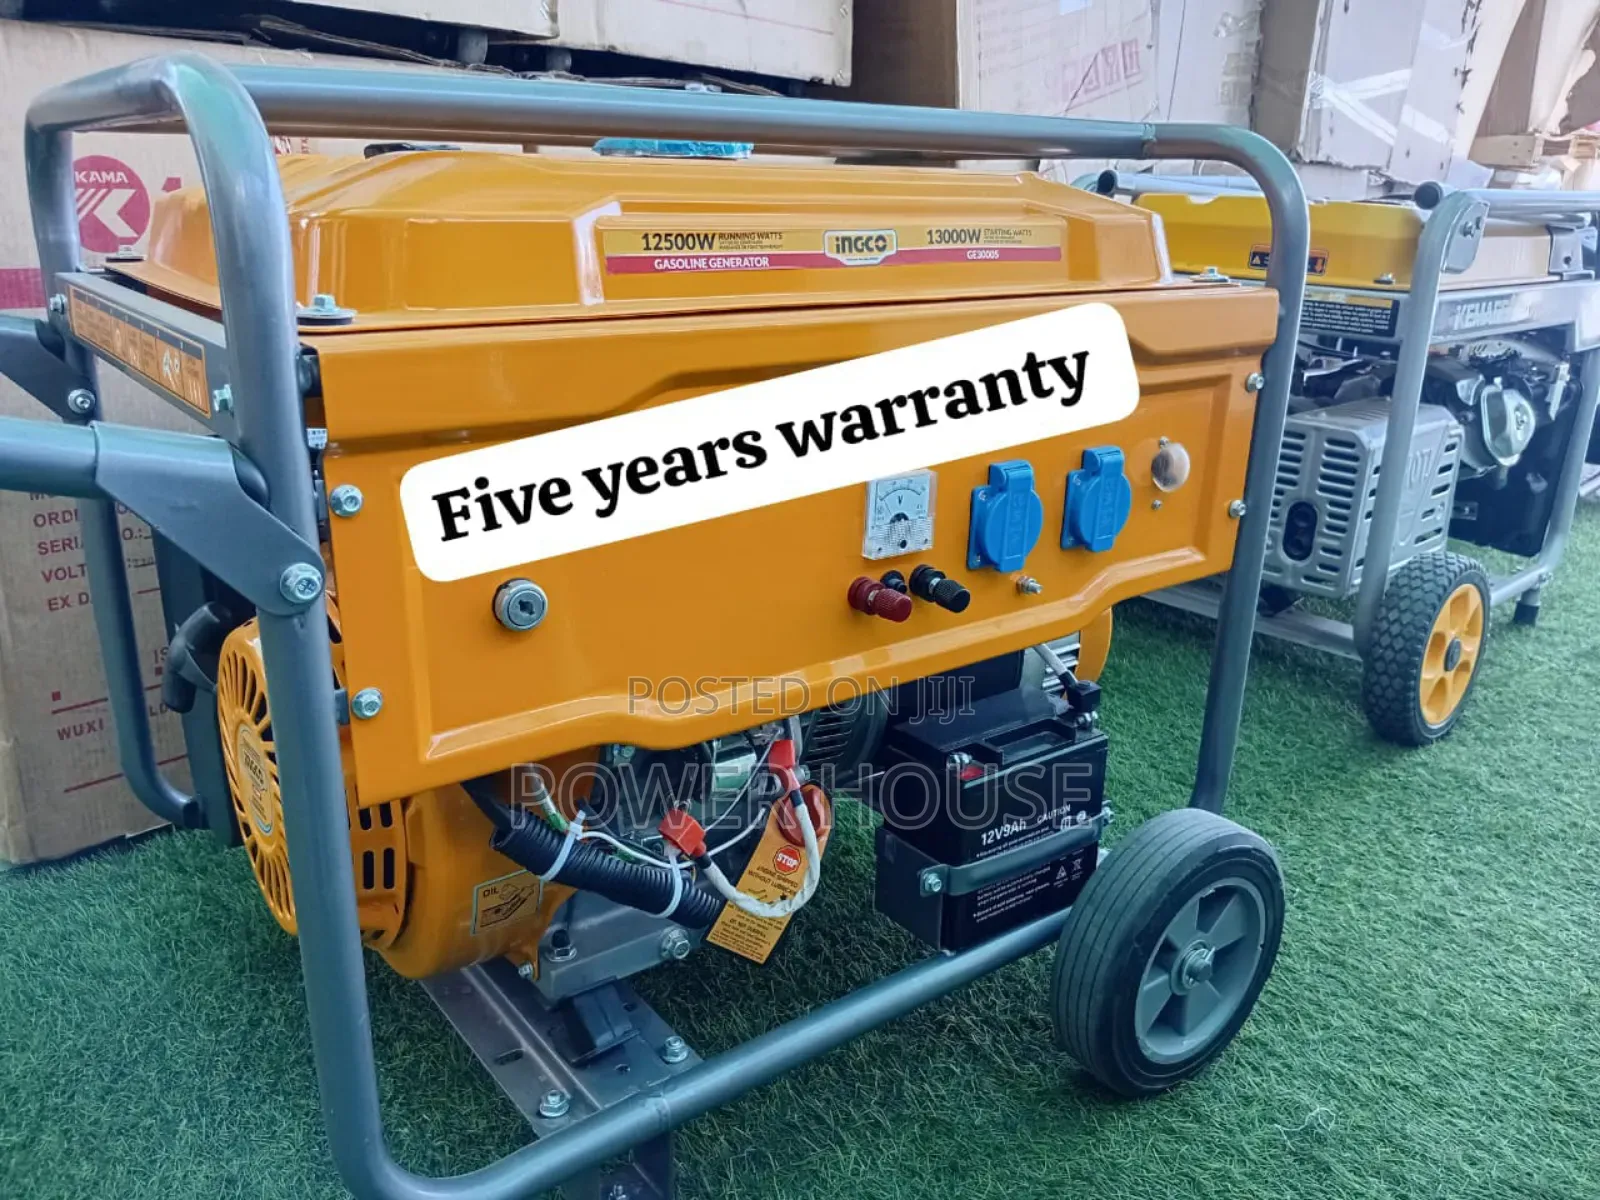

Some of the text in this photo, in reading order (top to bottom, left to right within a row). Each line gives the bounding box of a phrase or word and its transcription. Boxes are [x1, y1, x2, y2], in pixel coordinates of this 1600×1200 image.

[74, 170, 129, 184] KAMA
[641, 232, 715, 251] 12500W
[718, 231, 756, 242] RUNNING
[757, 230, 783, 241] WATTS
[926, 228, 981, 245] 13000W
[983, 228, 1012, 236] STARTING
[1012, 229, 1032, 237] WATTS
[654, 256, 769, 270] GASOLINE GENERATOR
[38, 536, 84, 556] SERI
[47, 592, 93, 612] EX D
[56, 718, 104, 740] WUXI
[981, 819, 1028, 846] 12V9Ah
[1036, 803, 1072, 824] CAUTION
[777, 852, 799, 868] STOP
[483, 886, 500, 898] OIL
